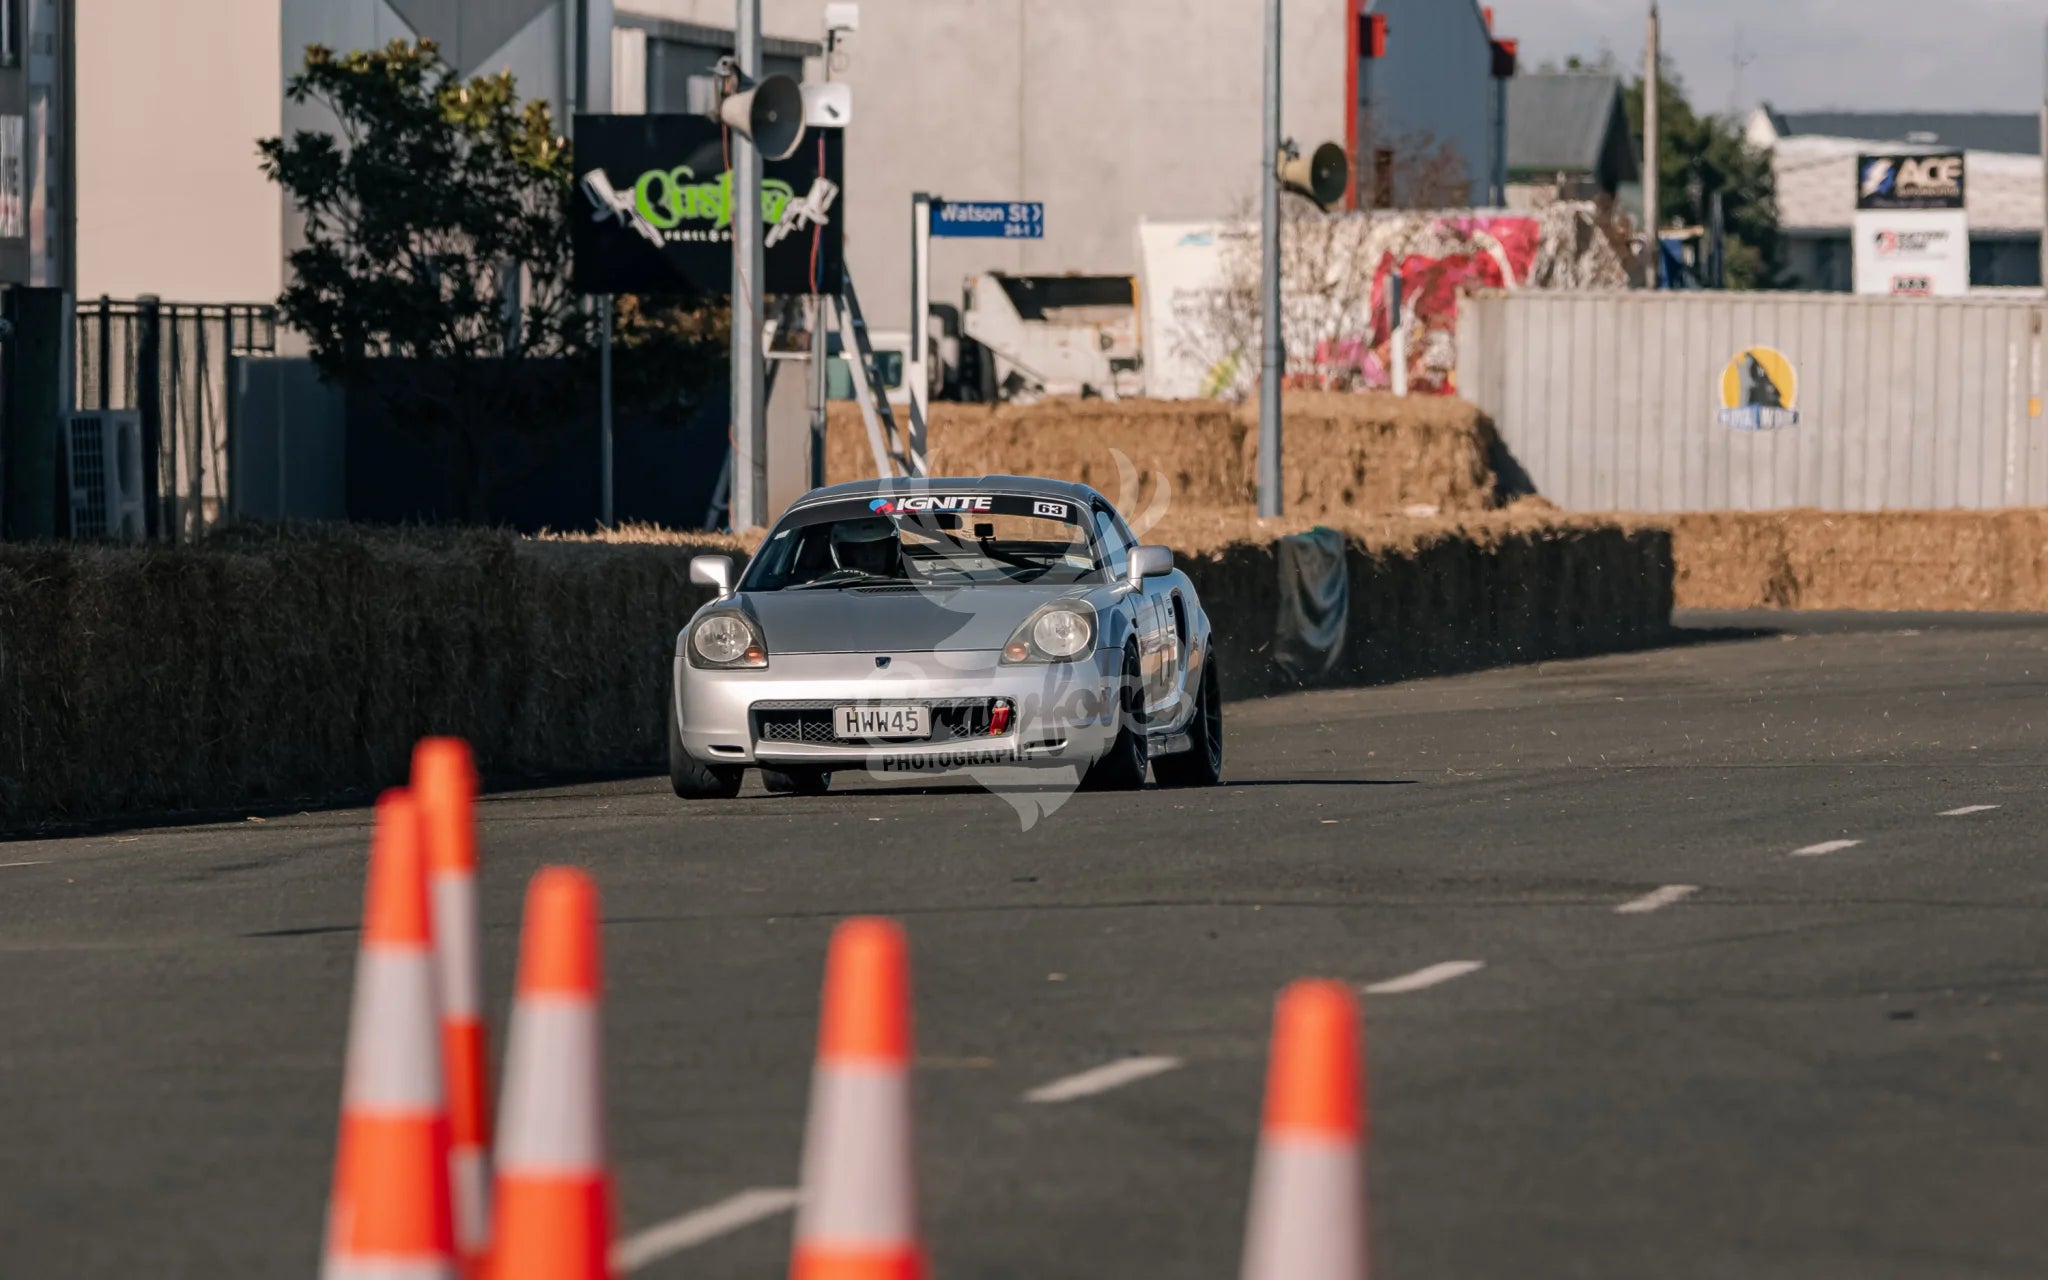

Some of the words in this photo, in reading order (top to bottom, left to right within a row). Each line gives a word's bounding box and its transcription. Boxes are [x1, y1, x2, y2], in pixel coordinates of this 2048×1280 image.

[1896, 157, 1963, 187] ACE
[941, 203, 1004, 222] Watson
[1008, 203, 1029, 222] St
[896, 496, 993, 510] IGNITE
[1038, 503, 1063, 515] 63
[846, 711, 919, 733] HWW45
